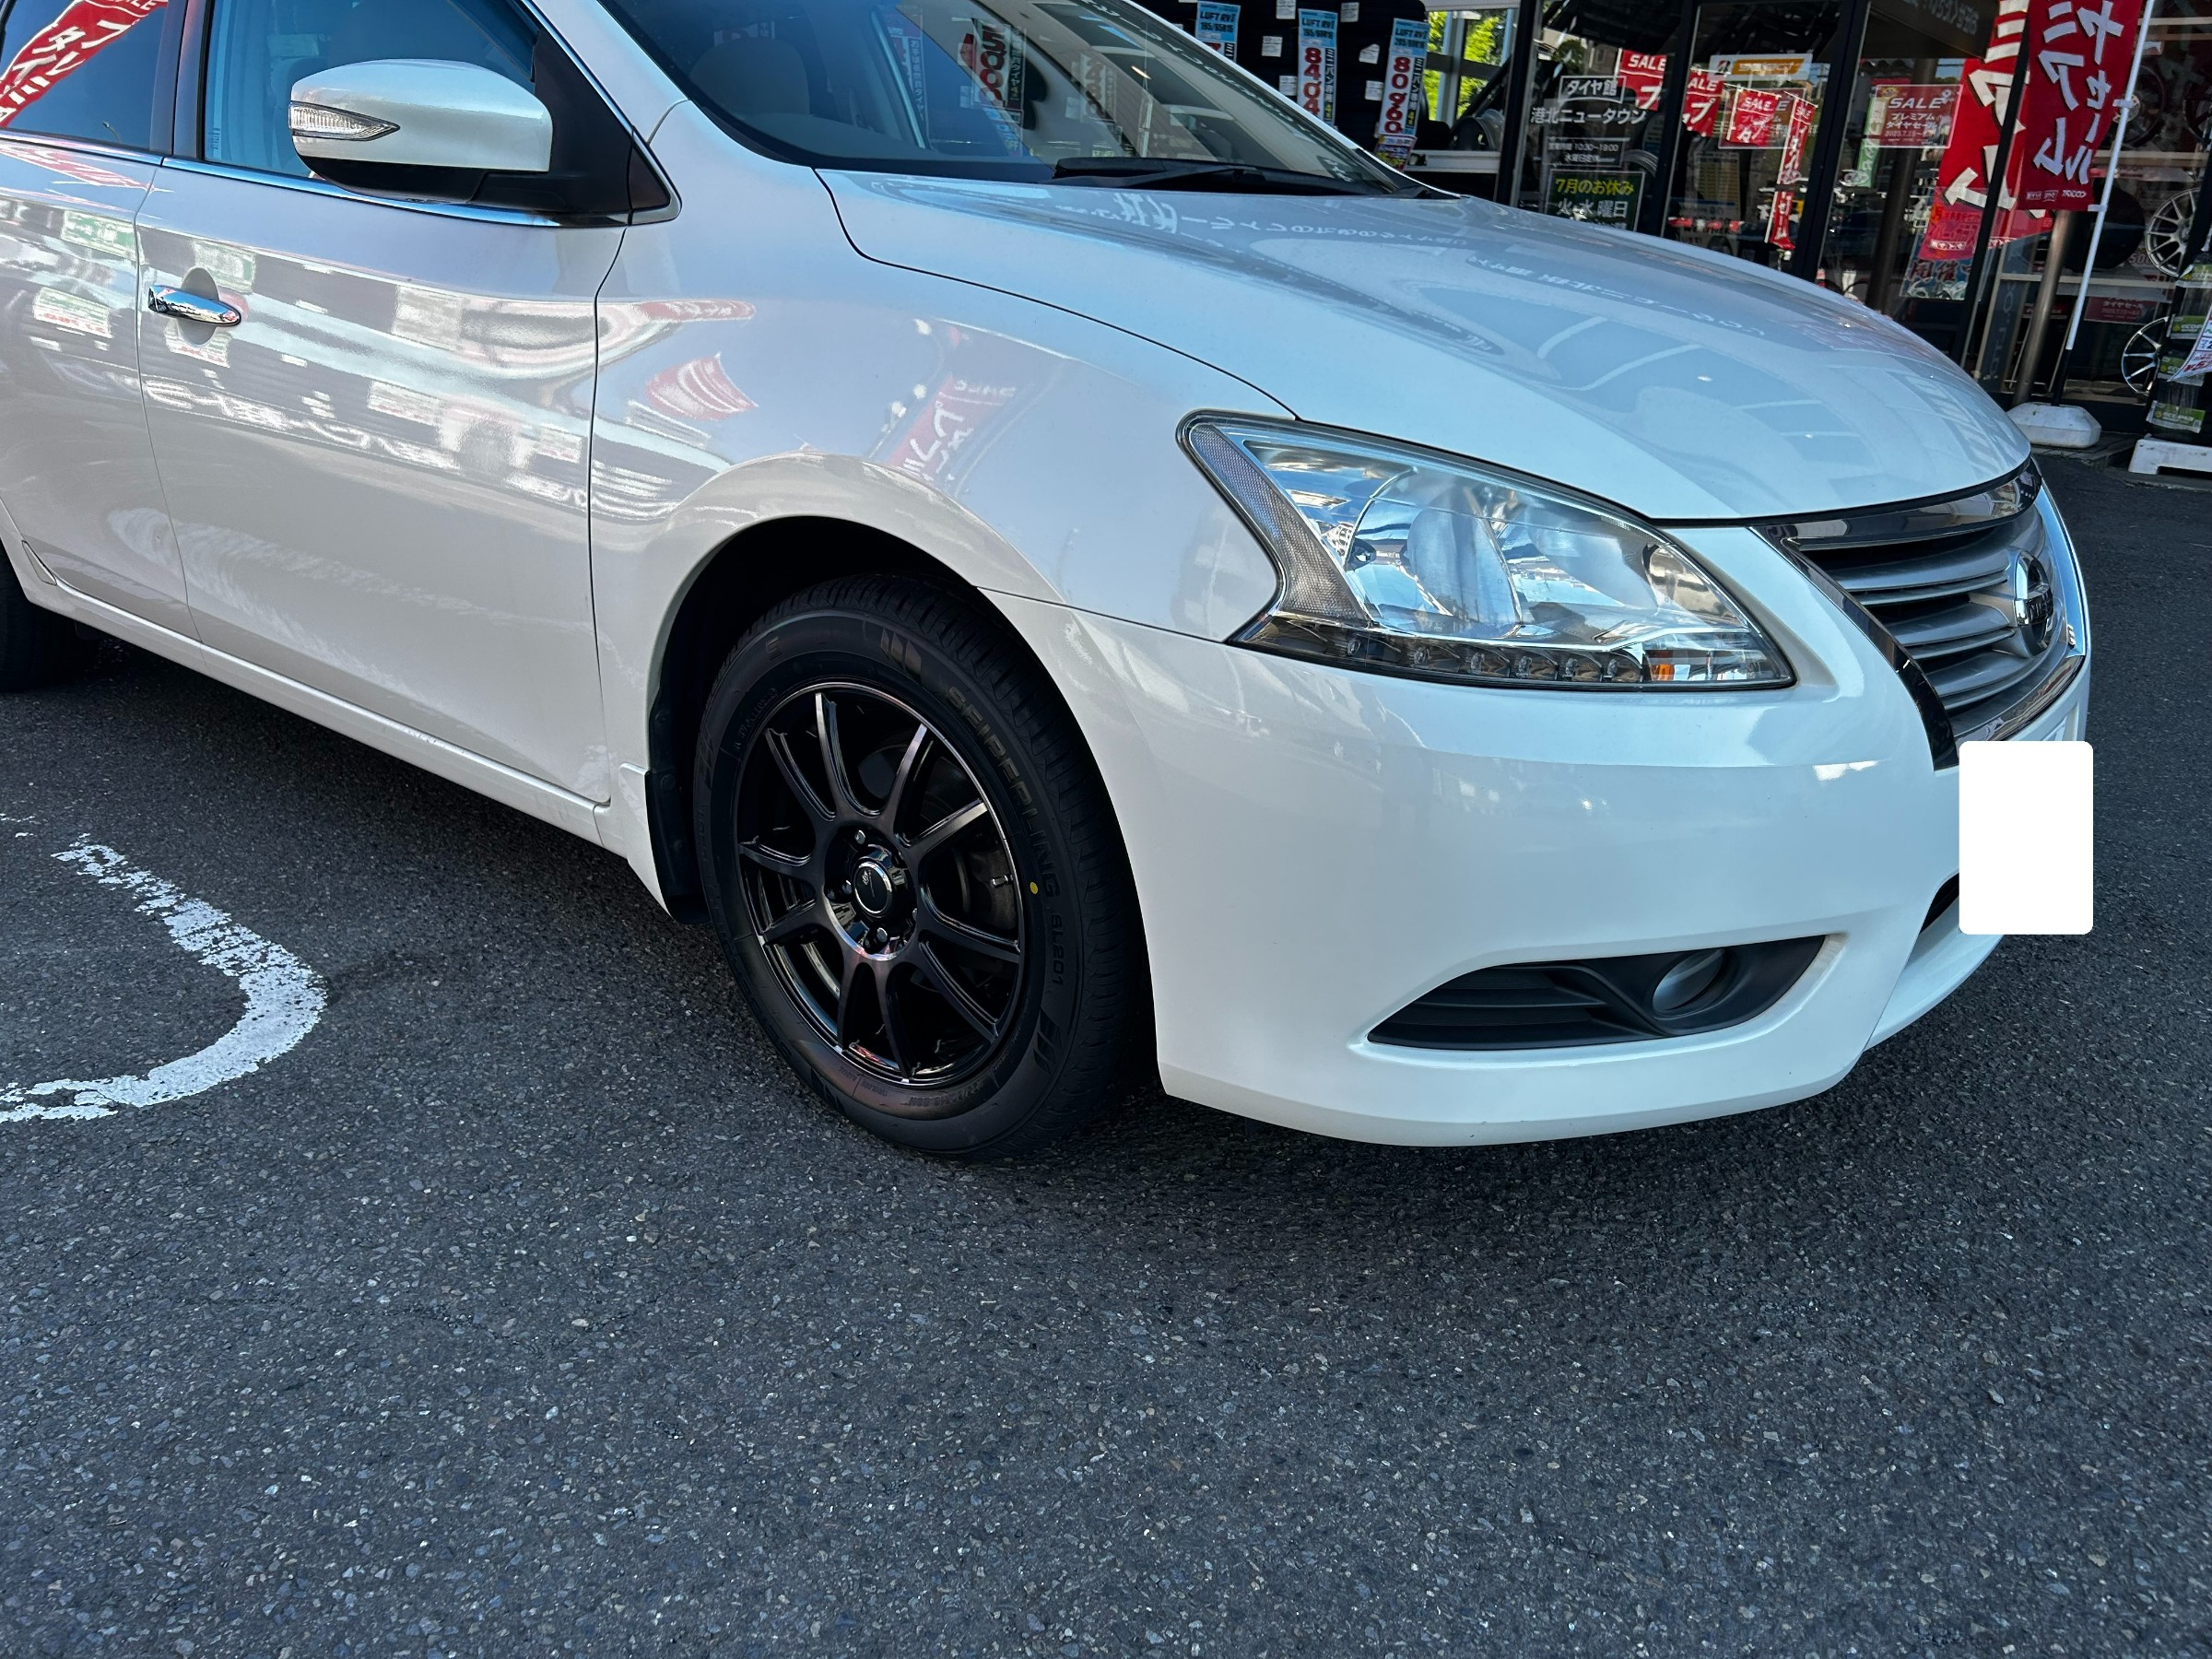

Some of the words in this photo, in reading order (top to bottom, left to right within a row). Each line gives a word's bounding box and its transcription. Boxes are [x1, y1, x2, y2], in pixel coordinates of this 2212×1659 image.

[1628, 54, 1666, 72] SALE
[1567, 79, 1618, 97] タイヤ館
[1687, 77, 1719, 91] ALE
[1888, 97, 1943, 109] SALE
[1531, 107, 1647, 125] 港北ニュータウン
[1556, 178, 1635, 195] 7月のお休み
[947, 685, 1061, 898] SEIBERLING
[1047, 912, 1065, 989] SL201
